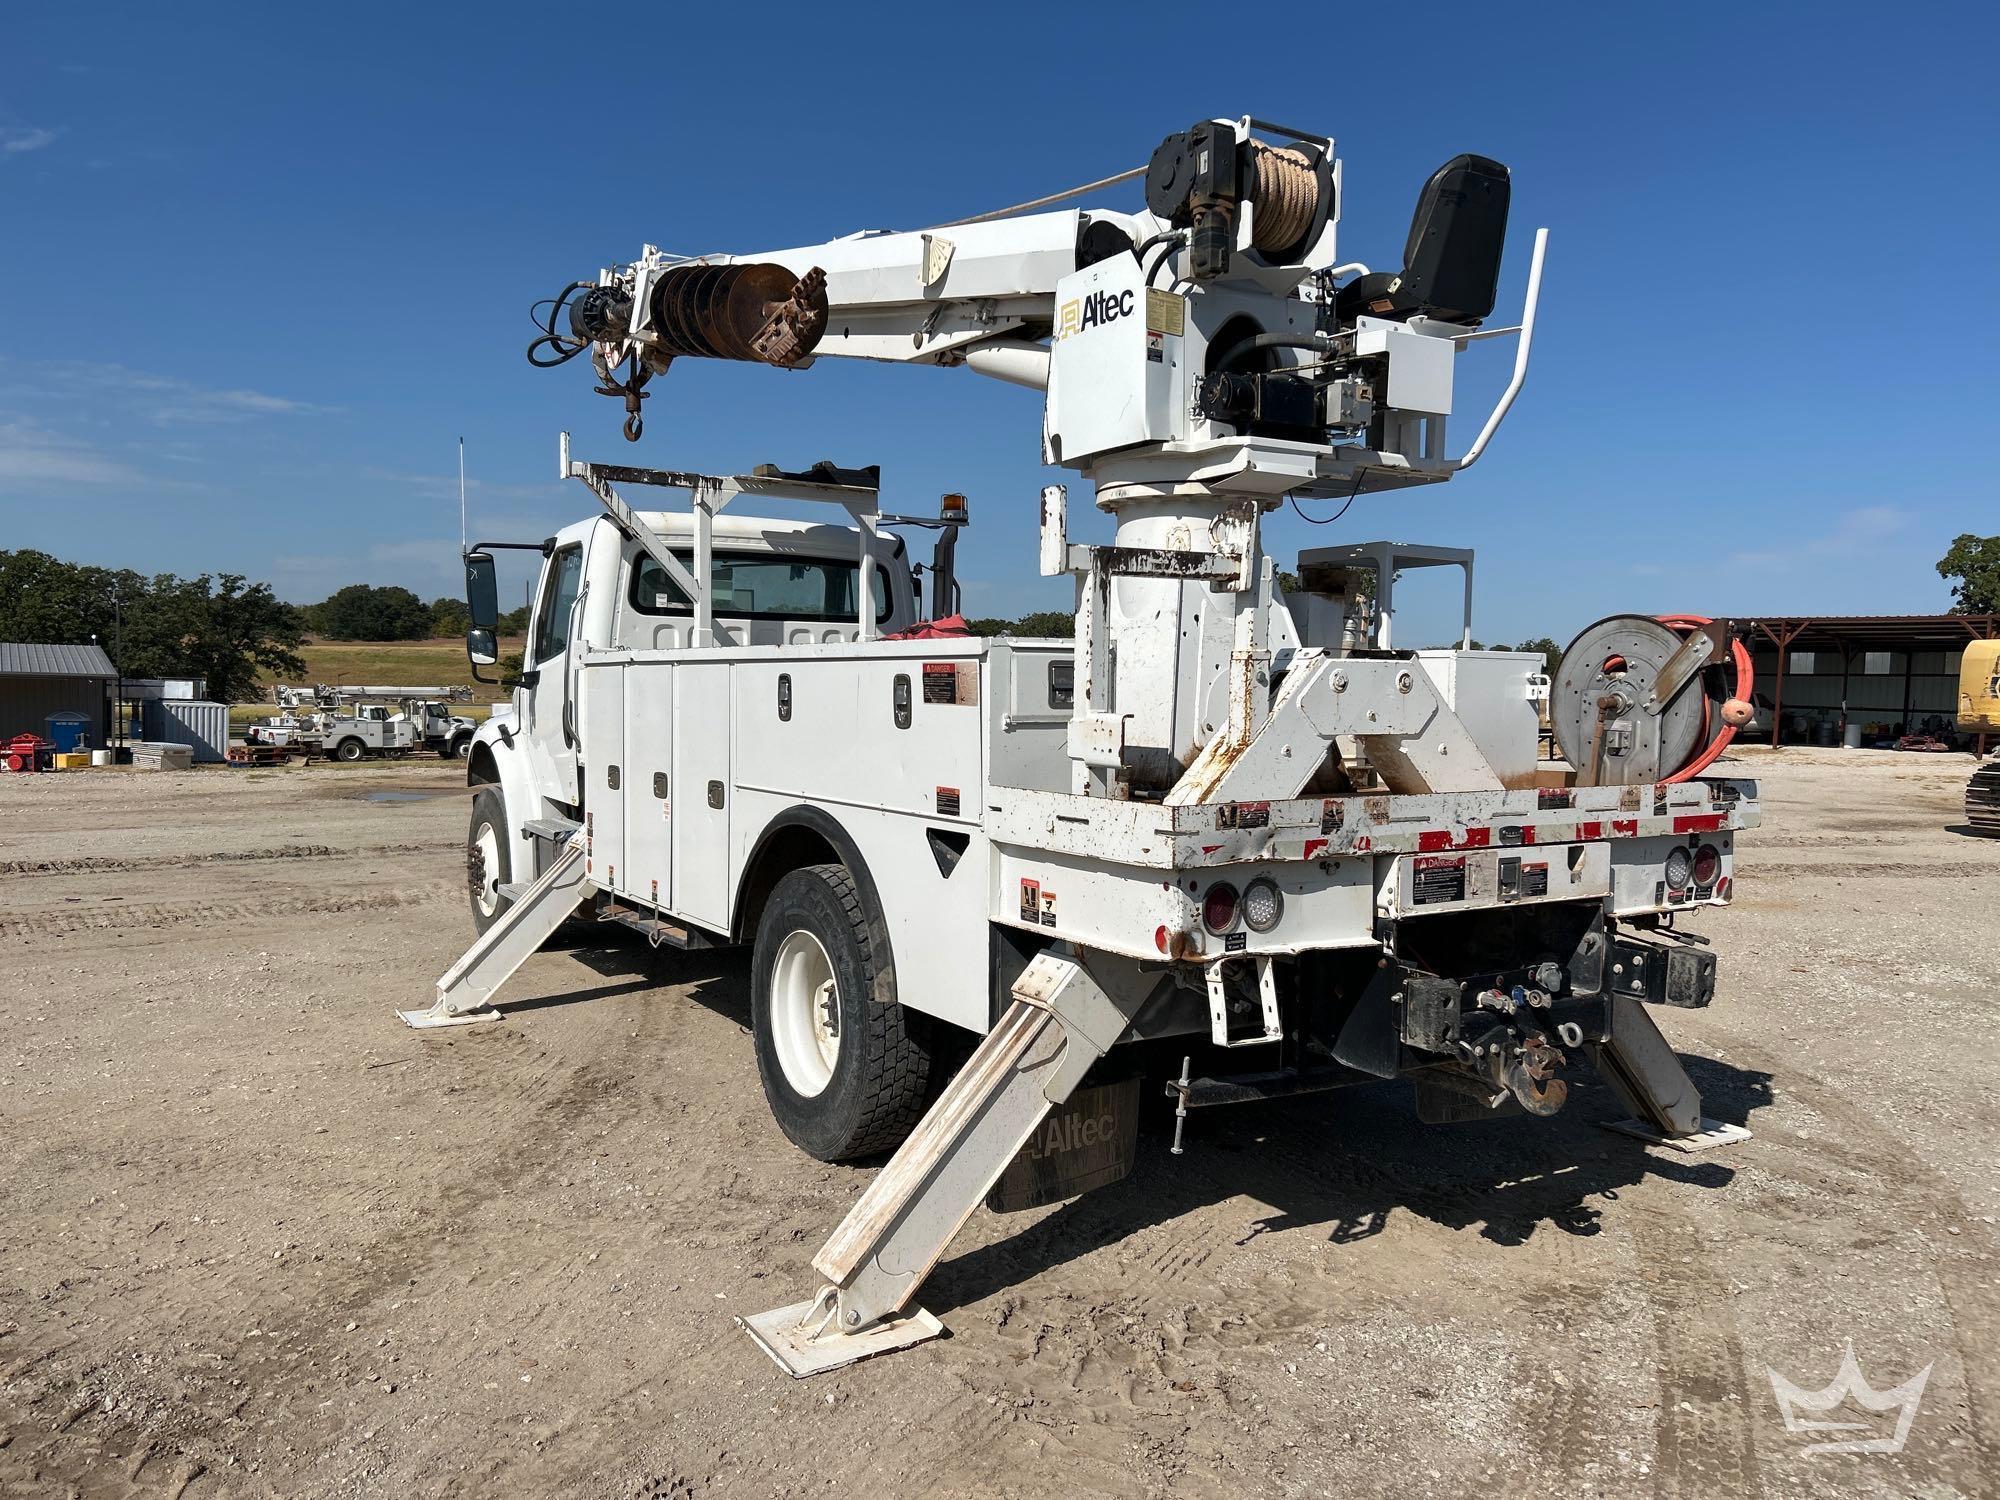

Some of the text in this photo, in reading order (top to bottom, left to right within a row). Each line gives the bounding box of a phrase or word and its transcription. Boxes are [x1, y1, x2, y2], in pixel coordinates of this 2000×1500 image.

[1081, 289, 1134, 332] Altec
[930, 664, 950, 673] DANGER
[1428, 858, 1458, 868] DANGER
[1044, 1112, 1114, 1157] Altec
